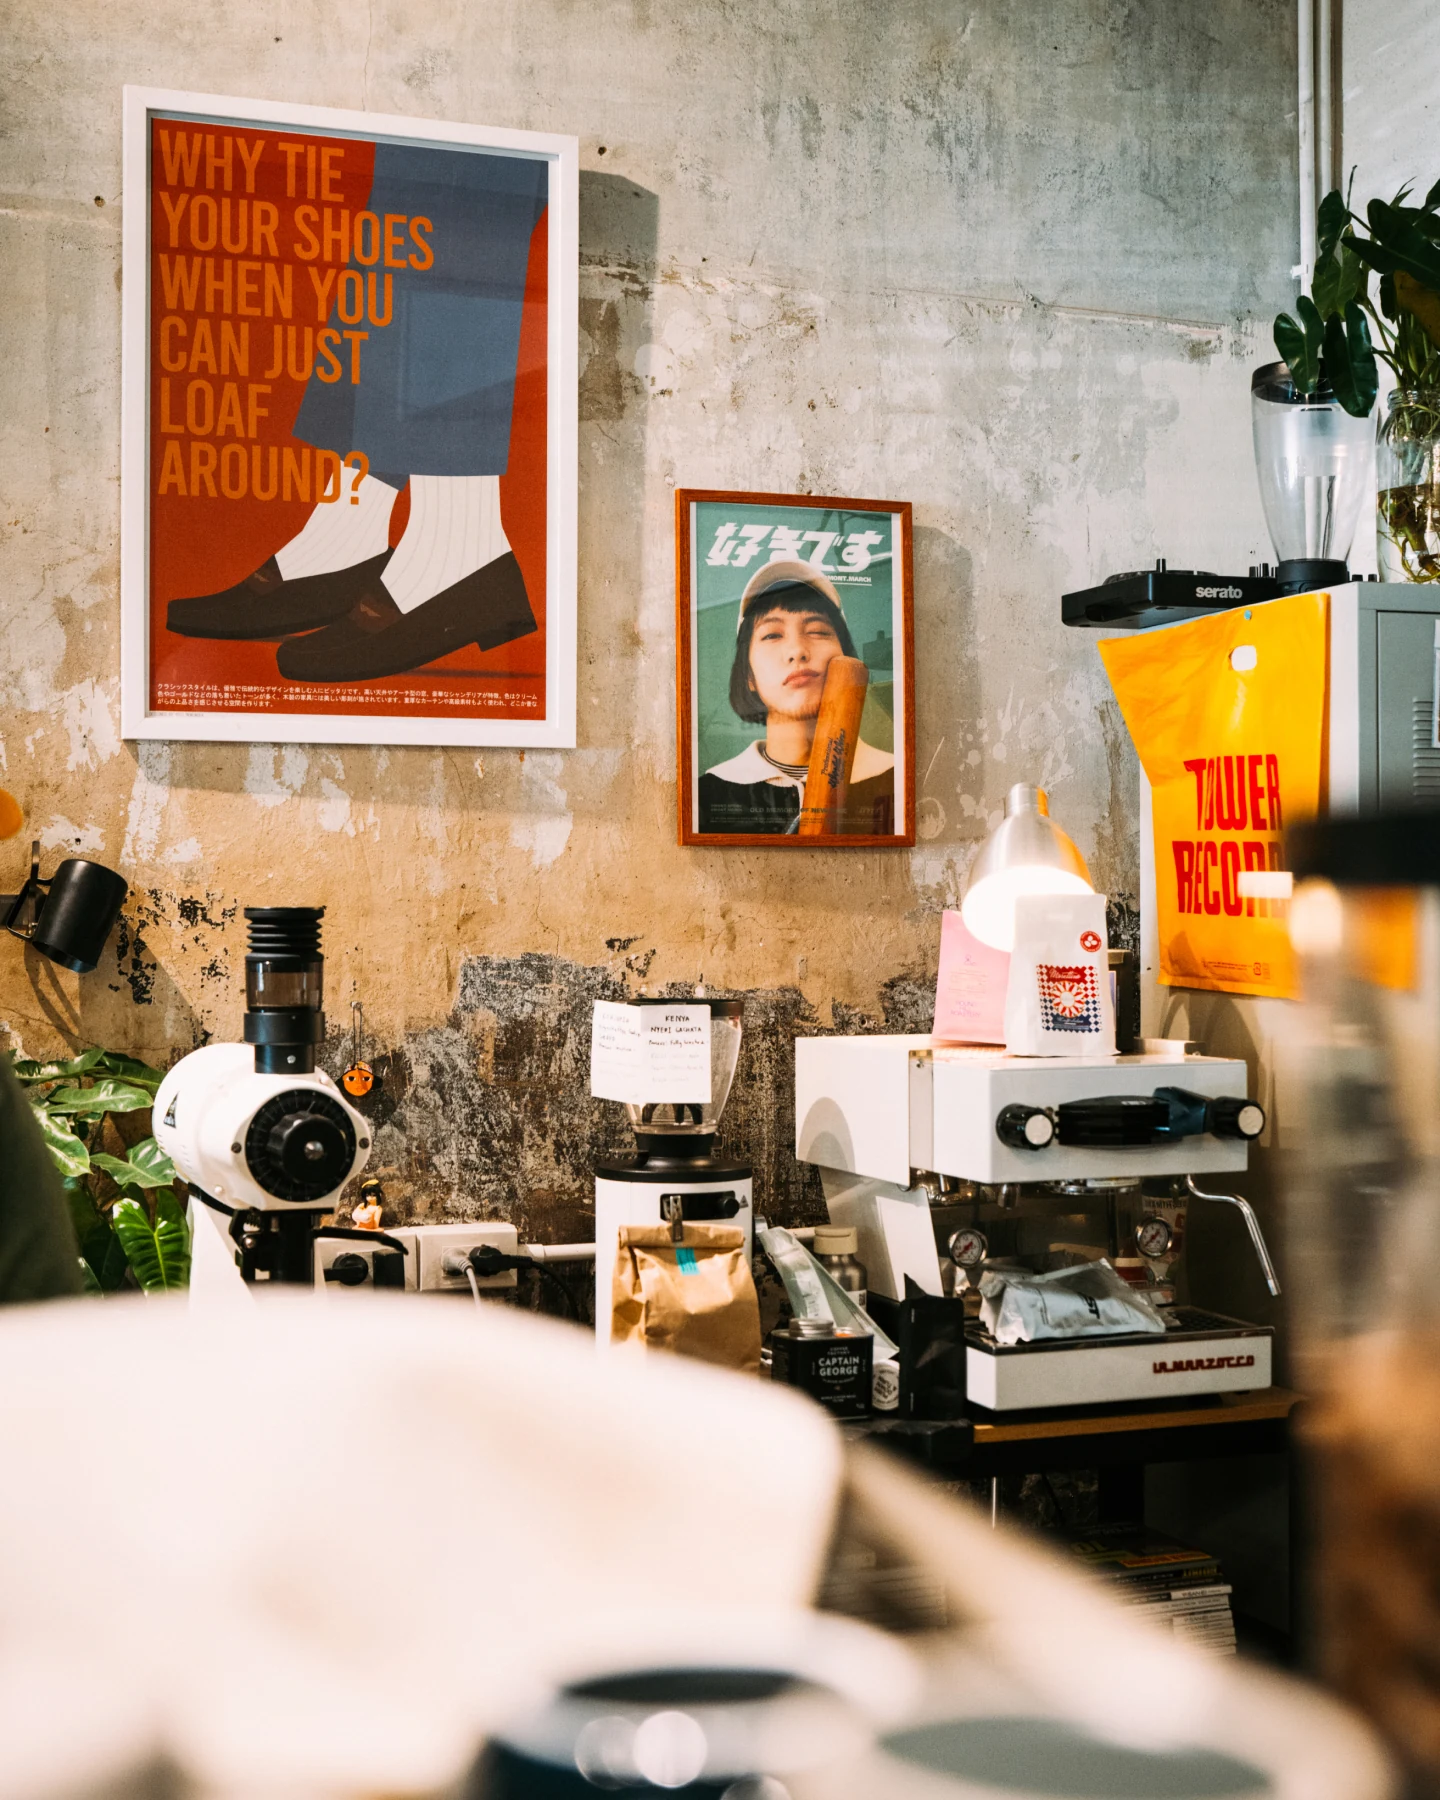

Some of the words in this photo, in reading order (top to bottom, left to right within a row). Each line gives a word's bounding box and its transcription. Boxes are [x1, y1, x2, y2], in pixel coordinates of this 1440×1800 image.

[159, 129, 266, 193] WHY
[278, 142, 345, 202] TIE
[159, 192, 279, 257] YOUR
[294, 205, 434, 271] SHOES
[159, 253, 293, 319] WHEN
[308, 266, 393, 327] YOU
[160, 316, 249, 376] CAN
[265, 324, 369, 385] JUST
[160, 377, 272, 439] LOAF
[158, 440, 370, 506] AROUND?
[705, 522, 886, 573] 好きです
[1195, 585, 1243, 599] serato
[1183, 753, 1283, 831] TOWER
[1172, 840, 1287, 918] RECORD
[818, 1356, 860, 1367] CAPTAIN
[819, 1366, 859, 1377] GEORGE
